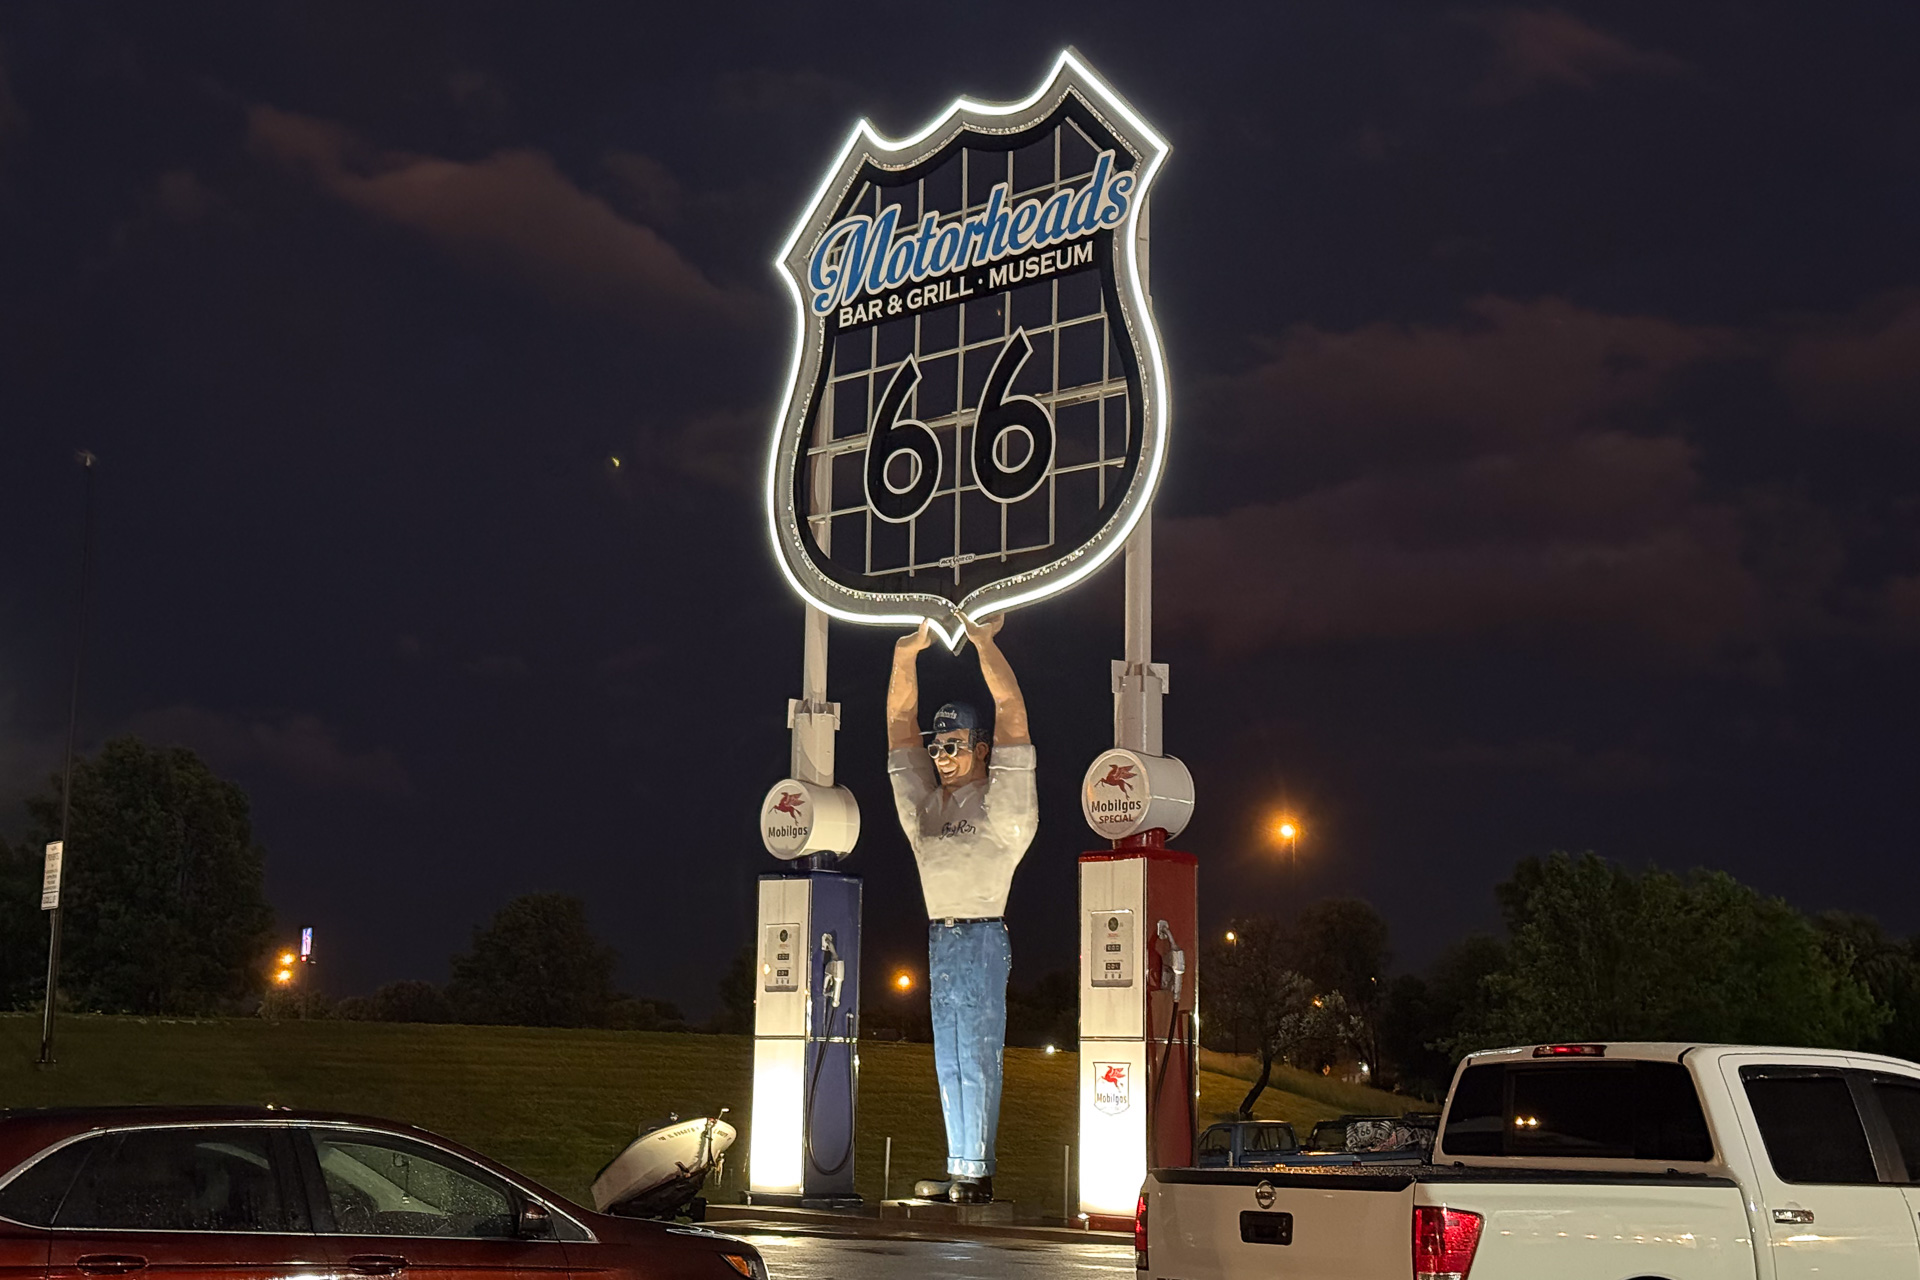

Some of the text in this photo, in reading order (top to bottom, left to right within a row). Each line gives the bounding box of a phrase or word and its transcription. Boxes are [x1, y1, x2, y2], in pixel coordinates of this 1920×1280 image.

[809, 150, 1136, 316] Motorheads
[838, 299, 883, 328] BAR
[887, 294, 903, 315] &
[906, 277, 973, 310] GRILL
[988, 241, 1093, 289] MUSEUM
[864, 326, 1056, 523] 66
[1091, 799, 1142, 813] Mobilgas
[1099, 814, 1134, 824] SPECIAL
[768, 825, 808, 839] Mobilgas
[1096, 1092, 1127, 1106] Mobilgas
